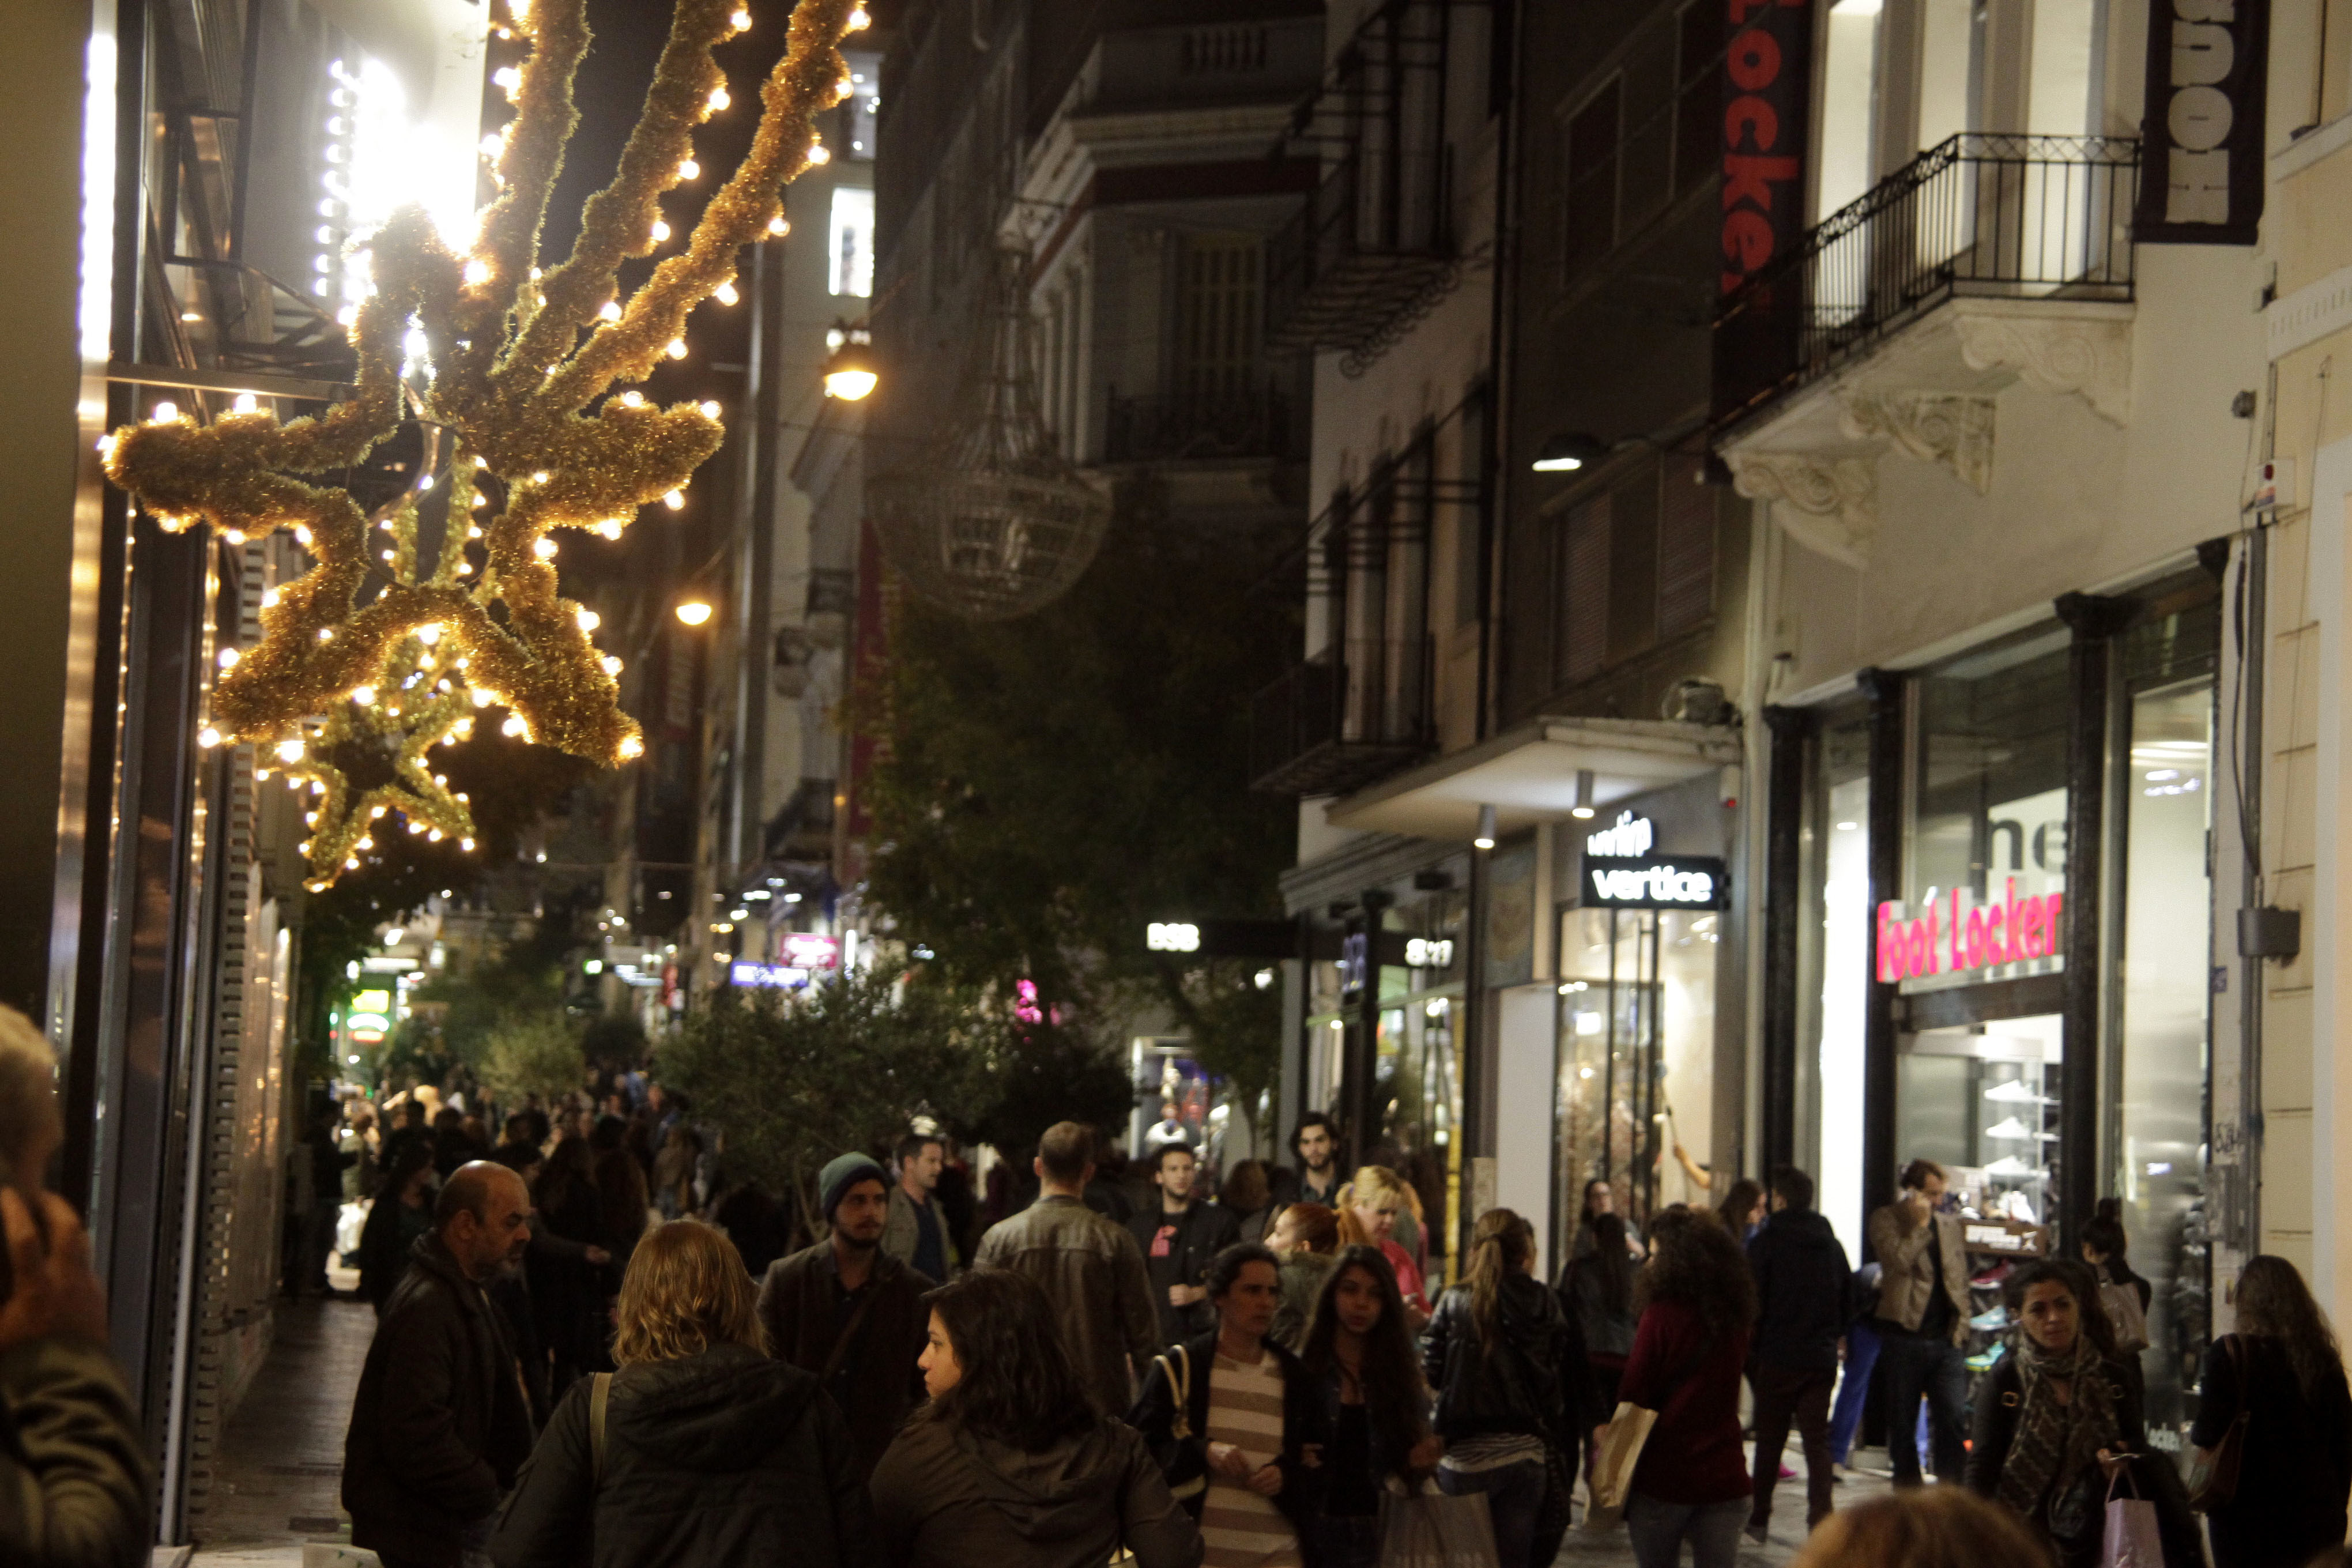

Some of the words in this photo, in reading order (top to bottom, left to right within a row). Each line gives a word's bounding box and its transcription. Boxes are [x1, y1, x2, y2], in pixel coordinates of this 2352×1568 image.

[1591, 865, 1713, 903] vertice
[1876, 898, 1939, 983] Foot
[1951, 876, 2062, 971] Locker
